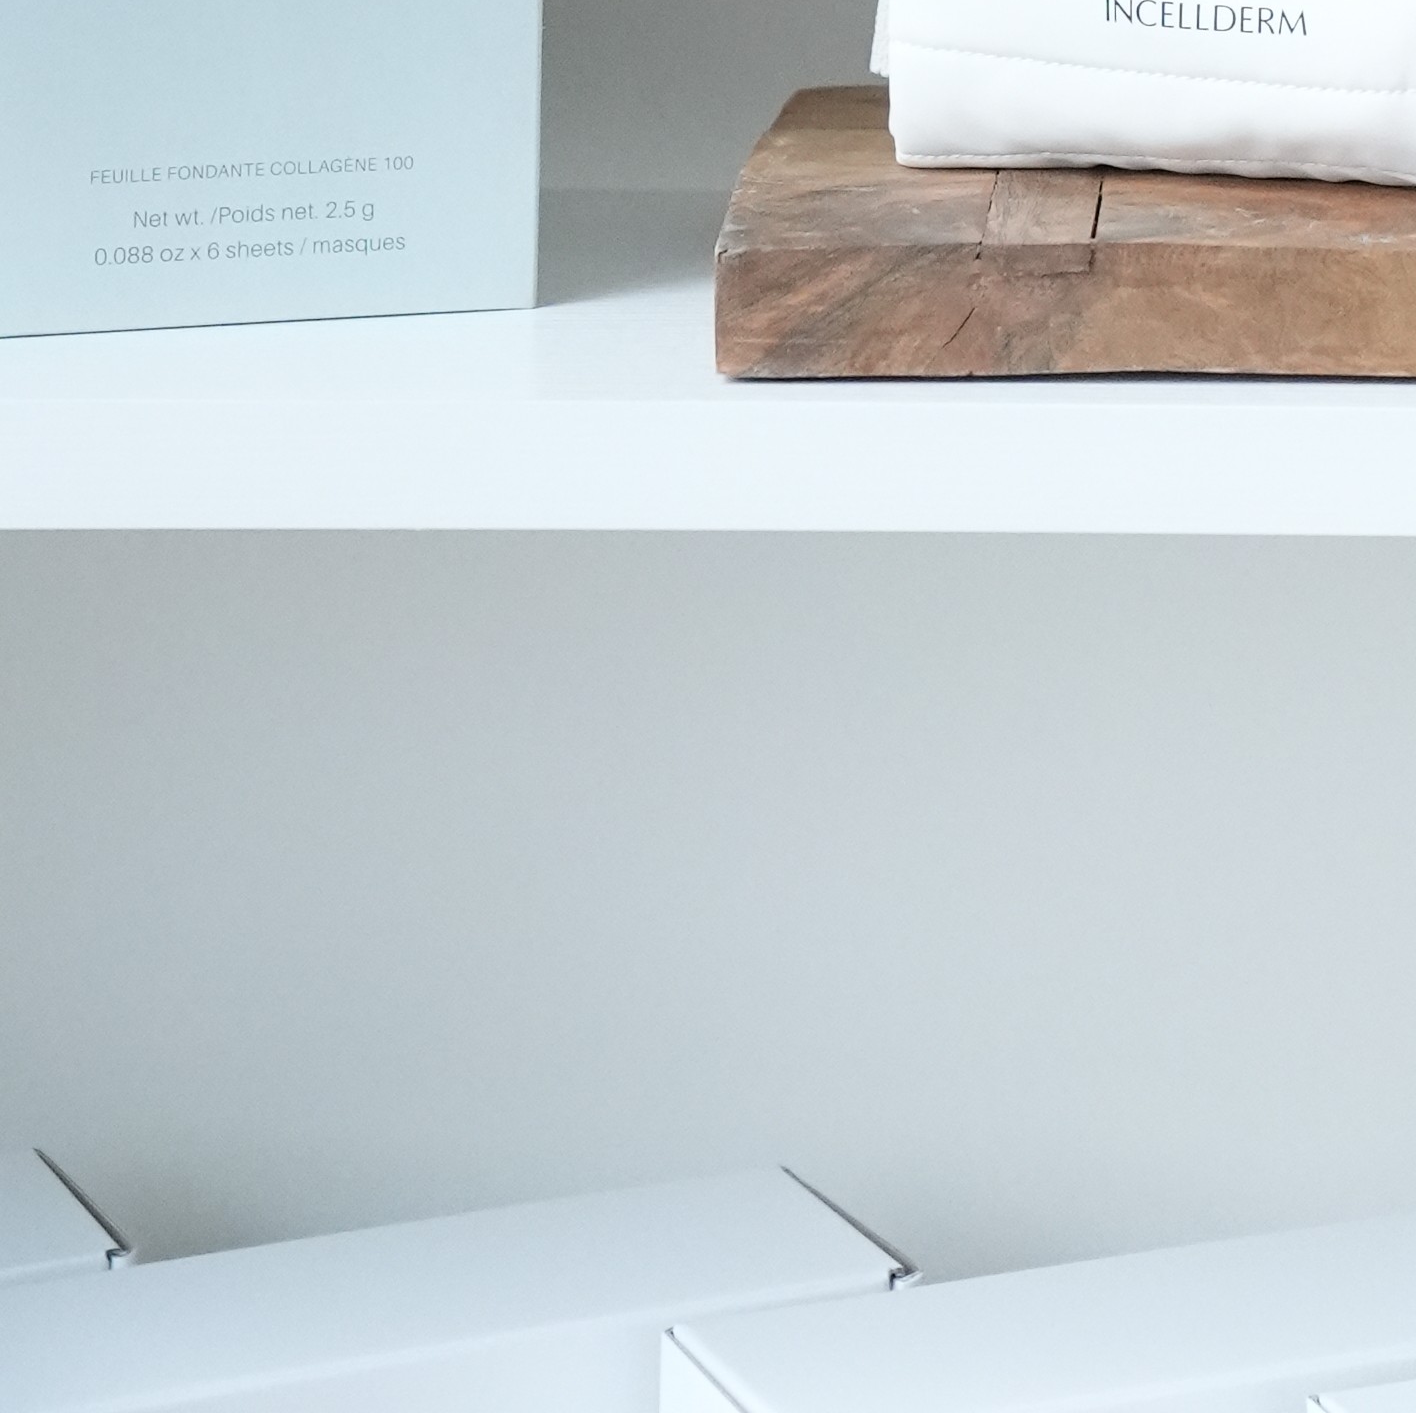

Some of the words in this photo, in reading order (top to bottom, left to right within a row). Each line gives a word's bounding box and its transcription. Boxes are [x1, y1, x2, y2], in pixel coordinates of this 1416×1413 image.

[90, 167, 162, 184] FEUILLE
[167, 162, 265, 181] FONDANTE
[270, 156, 377, 177] COLLAGÈNE
[383, 155, 414, 170] 100
[133, 210, 168, 228] Net
[175, 209, 204, 226] wt.
[281, 205, 318, 220] net.
[325, 201, 356, 219] 2.5
[362, 203, 375, 221] g
[94, 246, 154, 265] 0.088
[160, 247, 184, 263] oz
[189, 247, 201, 260] x
[207, 242, 220, 260] 6
[225, 240, 294, 259] sheets
[300, 237, 307, 255] /
[312, 236, 406, 256] masques
